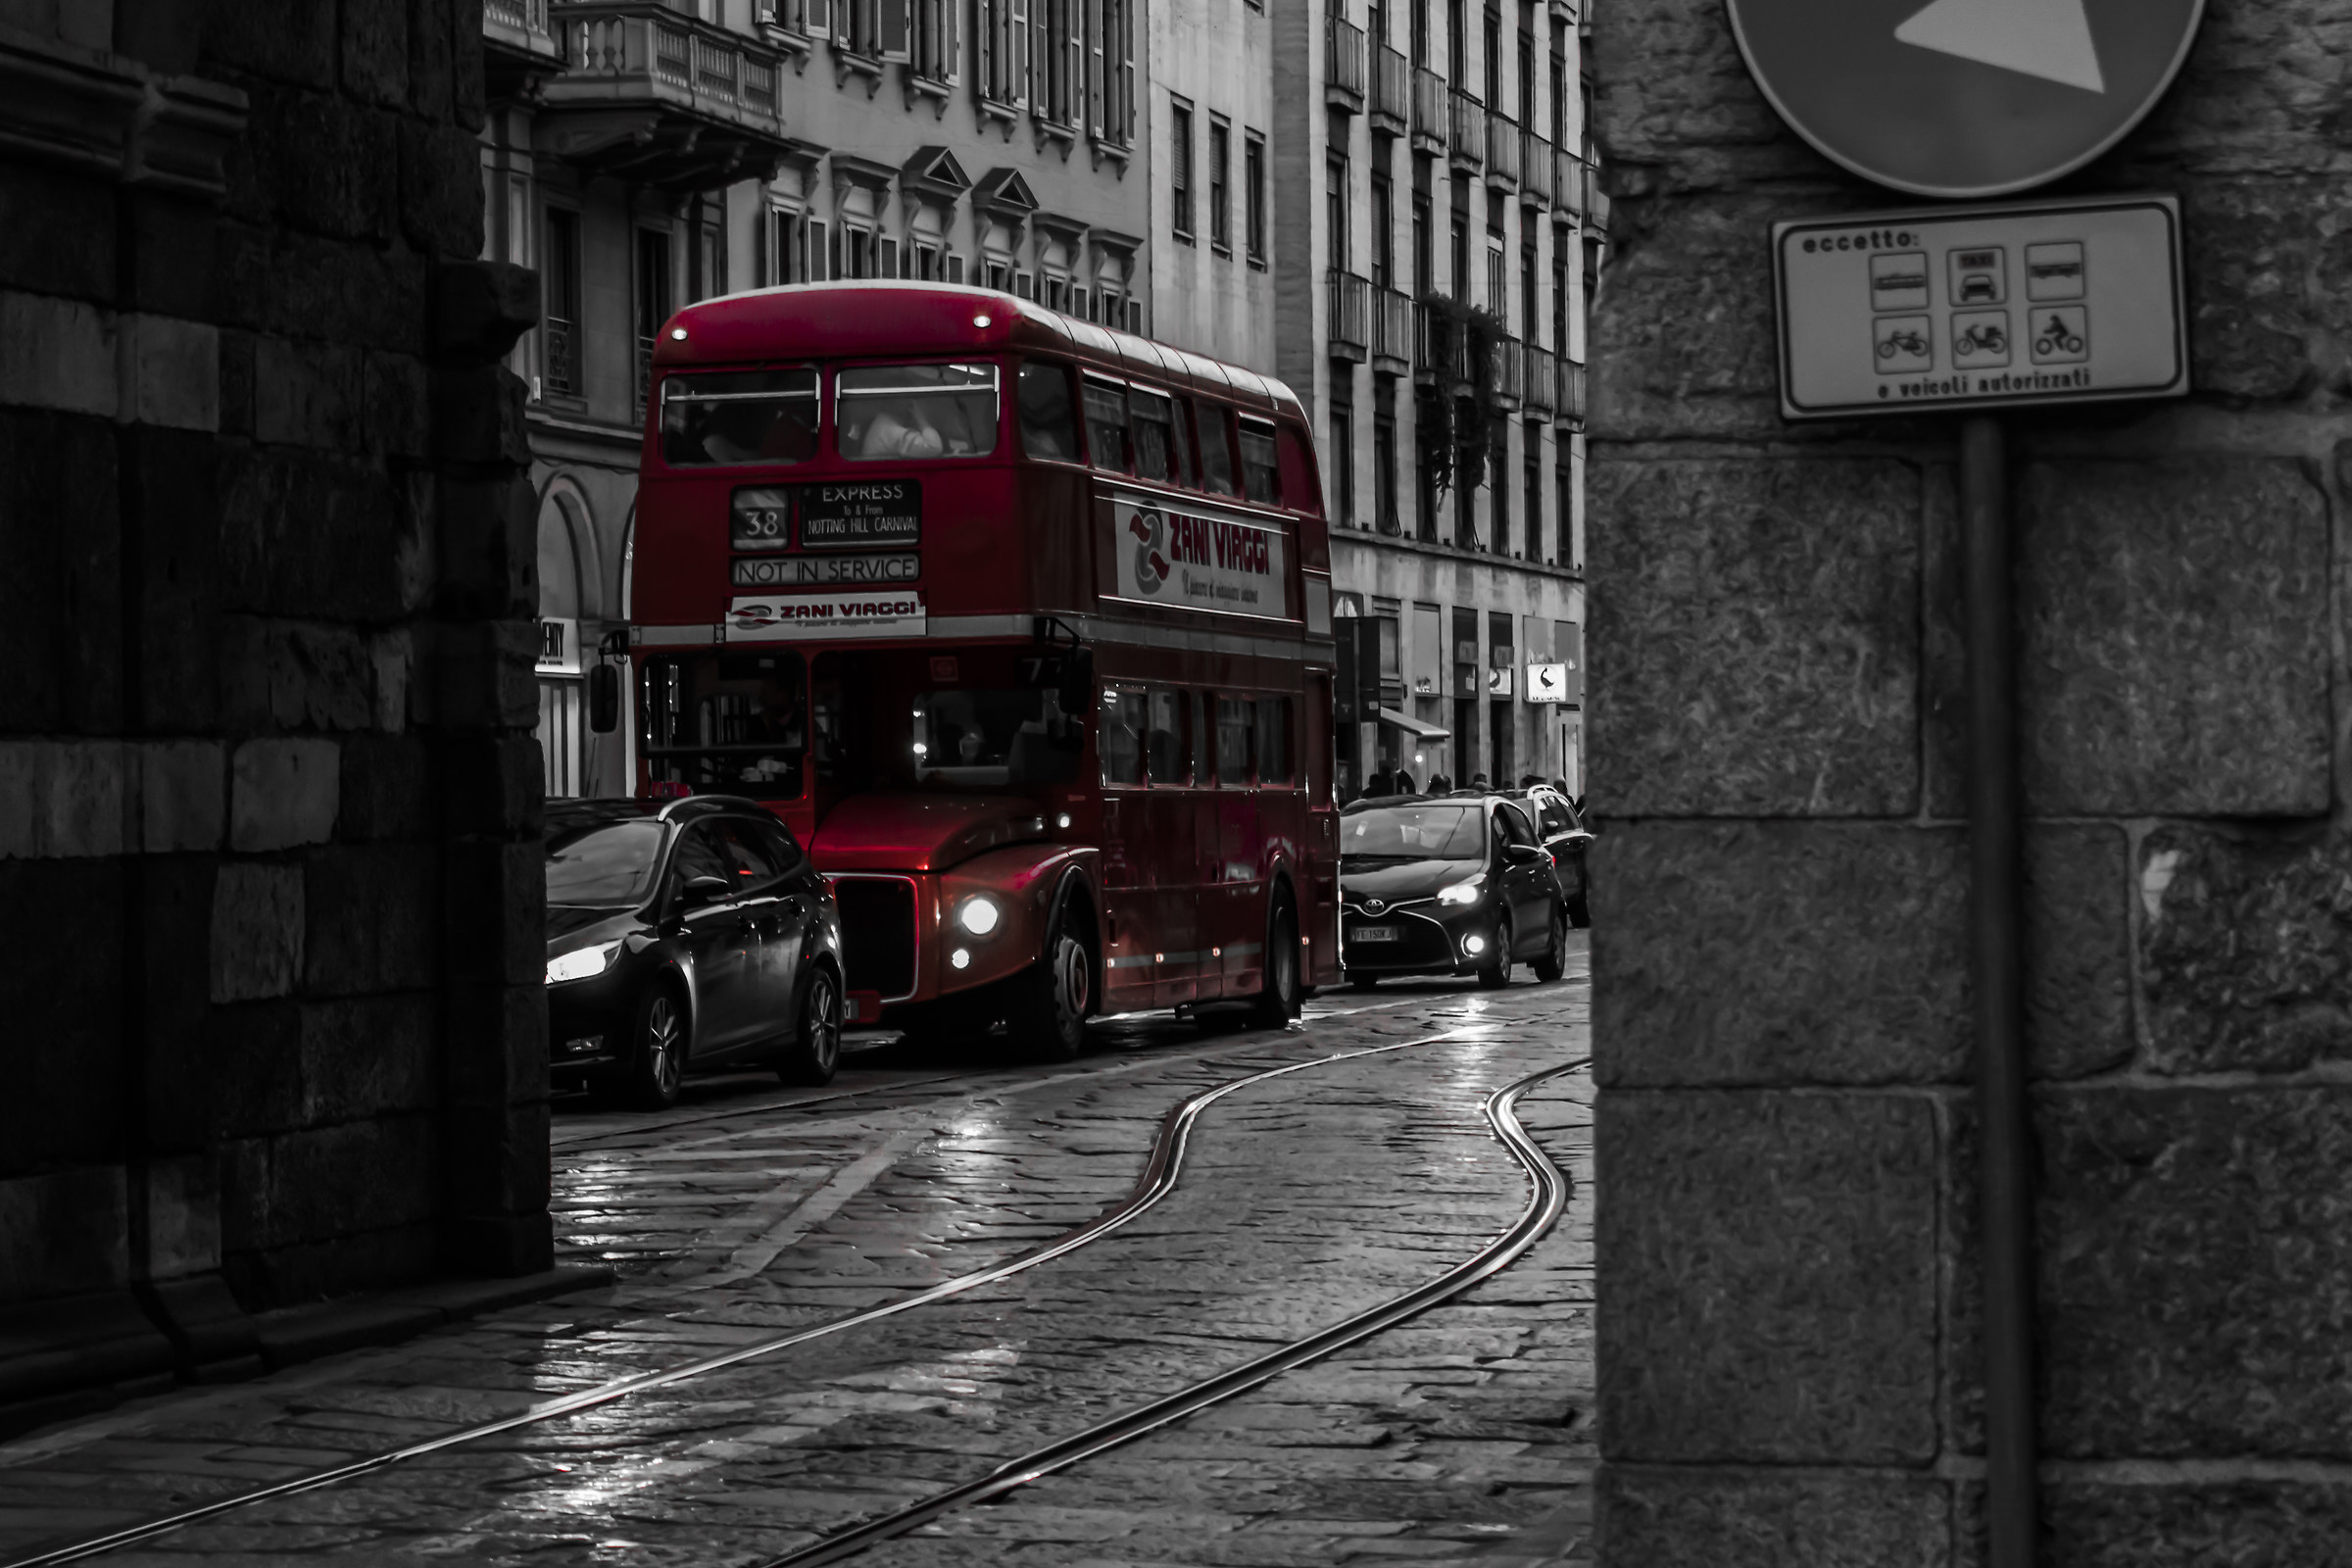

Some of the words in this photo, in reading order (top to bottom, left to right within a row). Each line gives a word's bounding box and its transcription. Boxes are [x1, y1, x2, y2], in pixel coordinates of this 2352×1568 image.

[1801, 228, 1921, 254] eccetto:
[1960, 253, 1993, 268] TAXI
[1877, 384, 1889, 399] e
[1899, 375, 1969, 397] veicoli
[1978, 368, 2091, 392] autorizzati
[821, 483, 905, 503] EXPRESS
[843, 504, 852, 516] To
[855, 504, 861, 515] &
[865, 503, 884, 515] From
[745, 511, 779, 537] 38
[808, 518, 846, 535] NOTTING
[850, 517, 869, 534] HILL
[874, 515, 918, 533] CARNIVAL
[1168, 512, 1211, 566] ZANI
[1213, 521, 1270, 576] VIAGGI
[738, 561, 788, 583] NOT
[796, 560, 819, 582] IN
[827, 558, 915, 581] SERVICE
[780, 604, 834, 619] ZANI
[838, 601, 917, 616] VIAGGI
